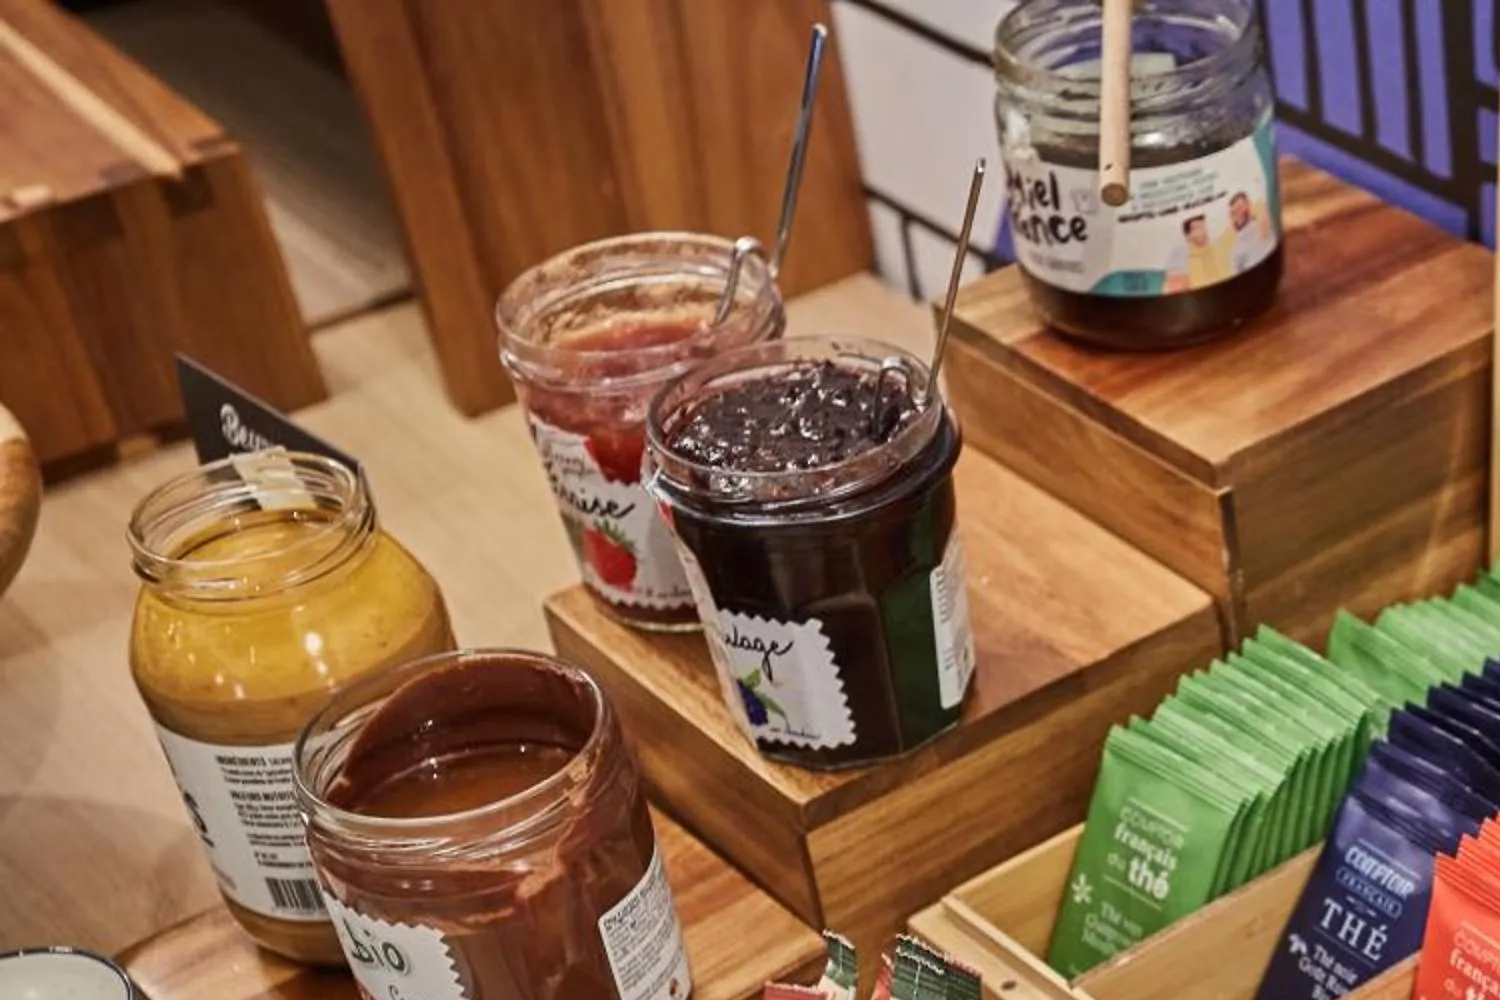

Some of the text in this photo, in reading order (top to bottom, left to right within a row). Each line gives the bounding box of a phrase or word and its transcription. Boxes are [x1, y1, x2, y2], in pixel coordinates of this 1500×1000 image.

[1128, 857, 1170, 899] thé
[1345, 846, 1415, 897] COMPTOIR
[1321, 897, 1388, 961] THÉ
